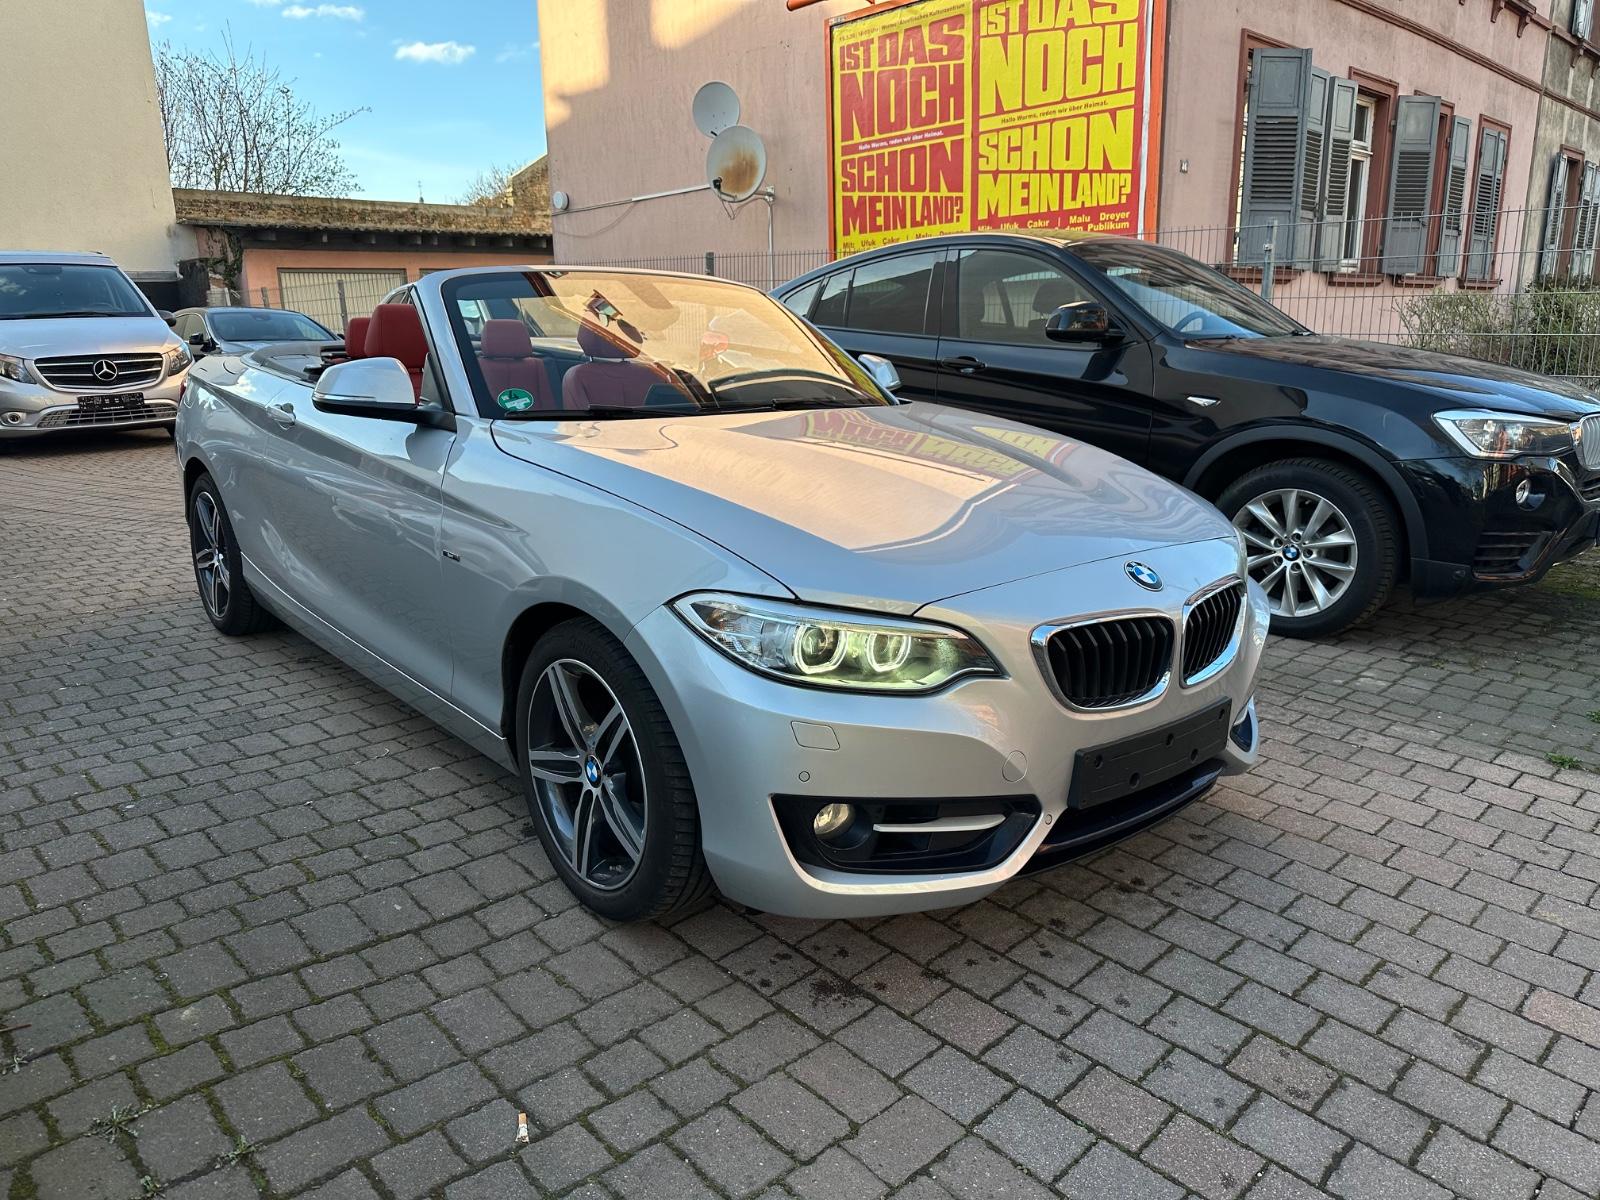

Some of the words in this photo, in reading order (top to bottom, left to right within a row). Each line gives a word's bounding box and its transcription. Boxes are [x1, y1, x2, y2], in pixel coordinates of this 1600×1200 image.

[980, 0, 1024, 36] IST
[839, 38, 874, 71] IST
[877, 14, 965, 67] DAS
[980, 22, 1139, 117] NOCH
[840, 62, 965, 142] NOCH
[1039, 109, 1056, 117] reden
[1068, 104, 1082, 112] über
[1083, 100, 1109, 110] Heimat.
[978, 109, 1135, 171] SCHON
[841, 139, 964, 193] SCHON
[841, 195, 907, 237] MEIN
[910, 195, 964, 229] LAND?
[977, 173, 1060, 220] MEIN
[1063, 173, 1132, 211] LAND?
[1000, 222, 1019, 230] Ufuk
[1069, 214, 1091, 224] Malu
[1099, 210, 1131, 221] Dreyer
[1087, 221, 1130, 232] Publikum
